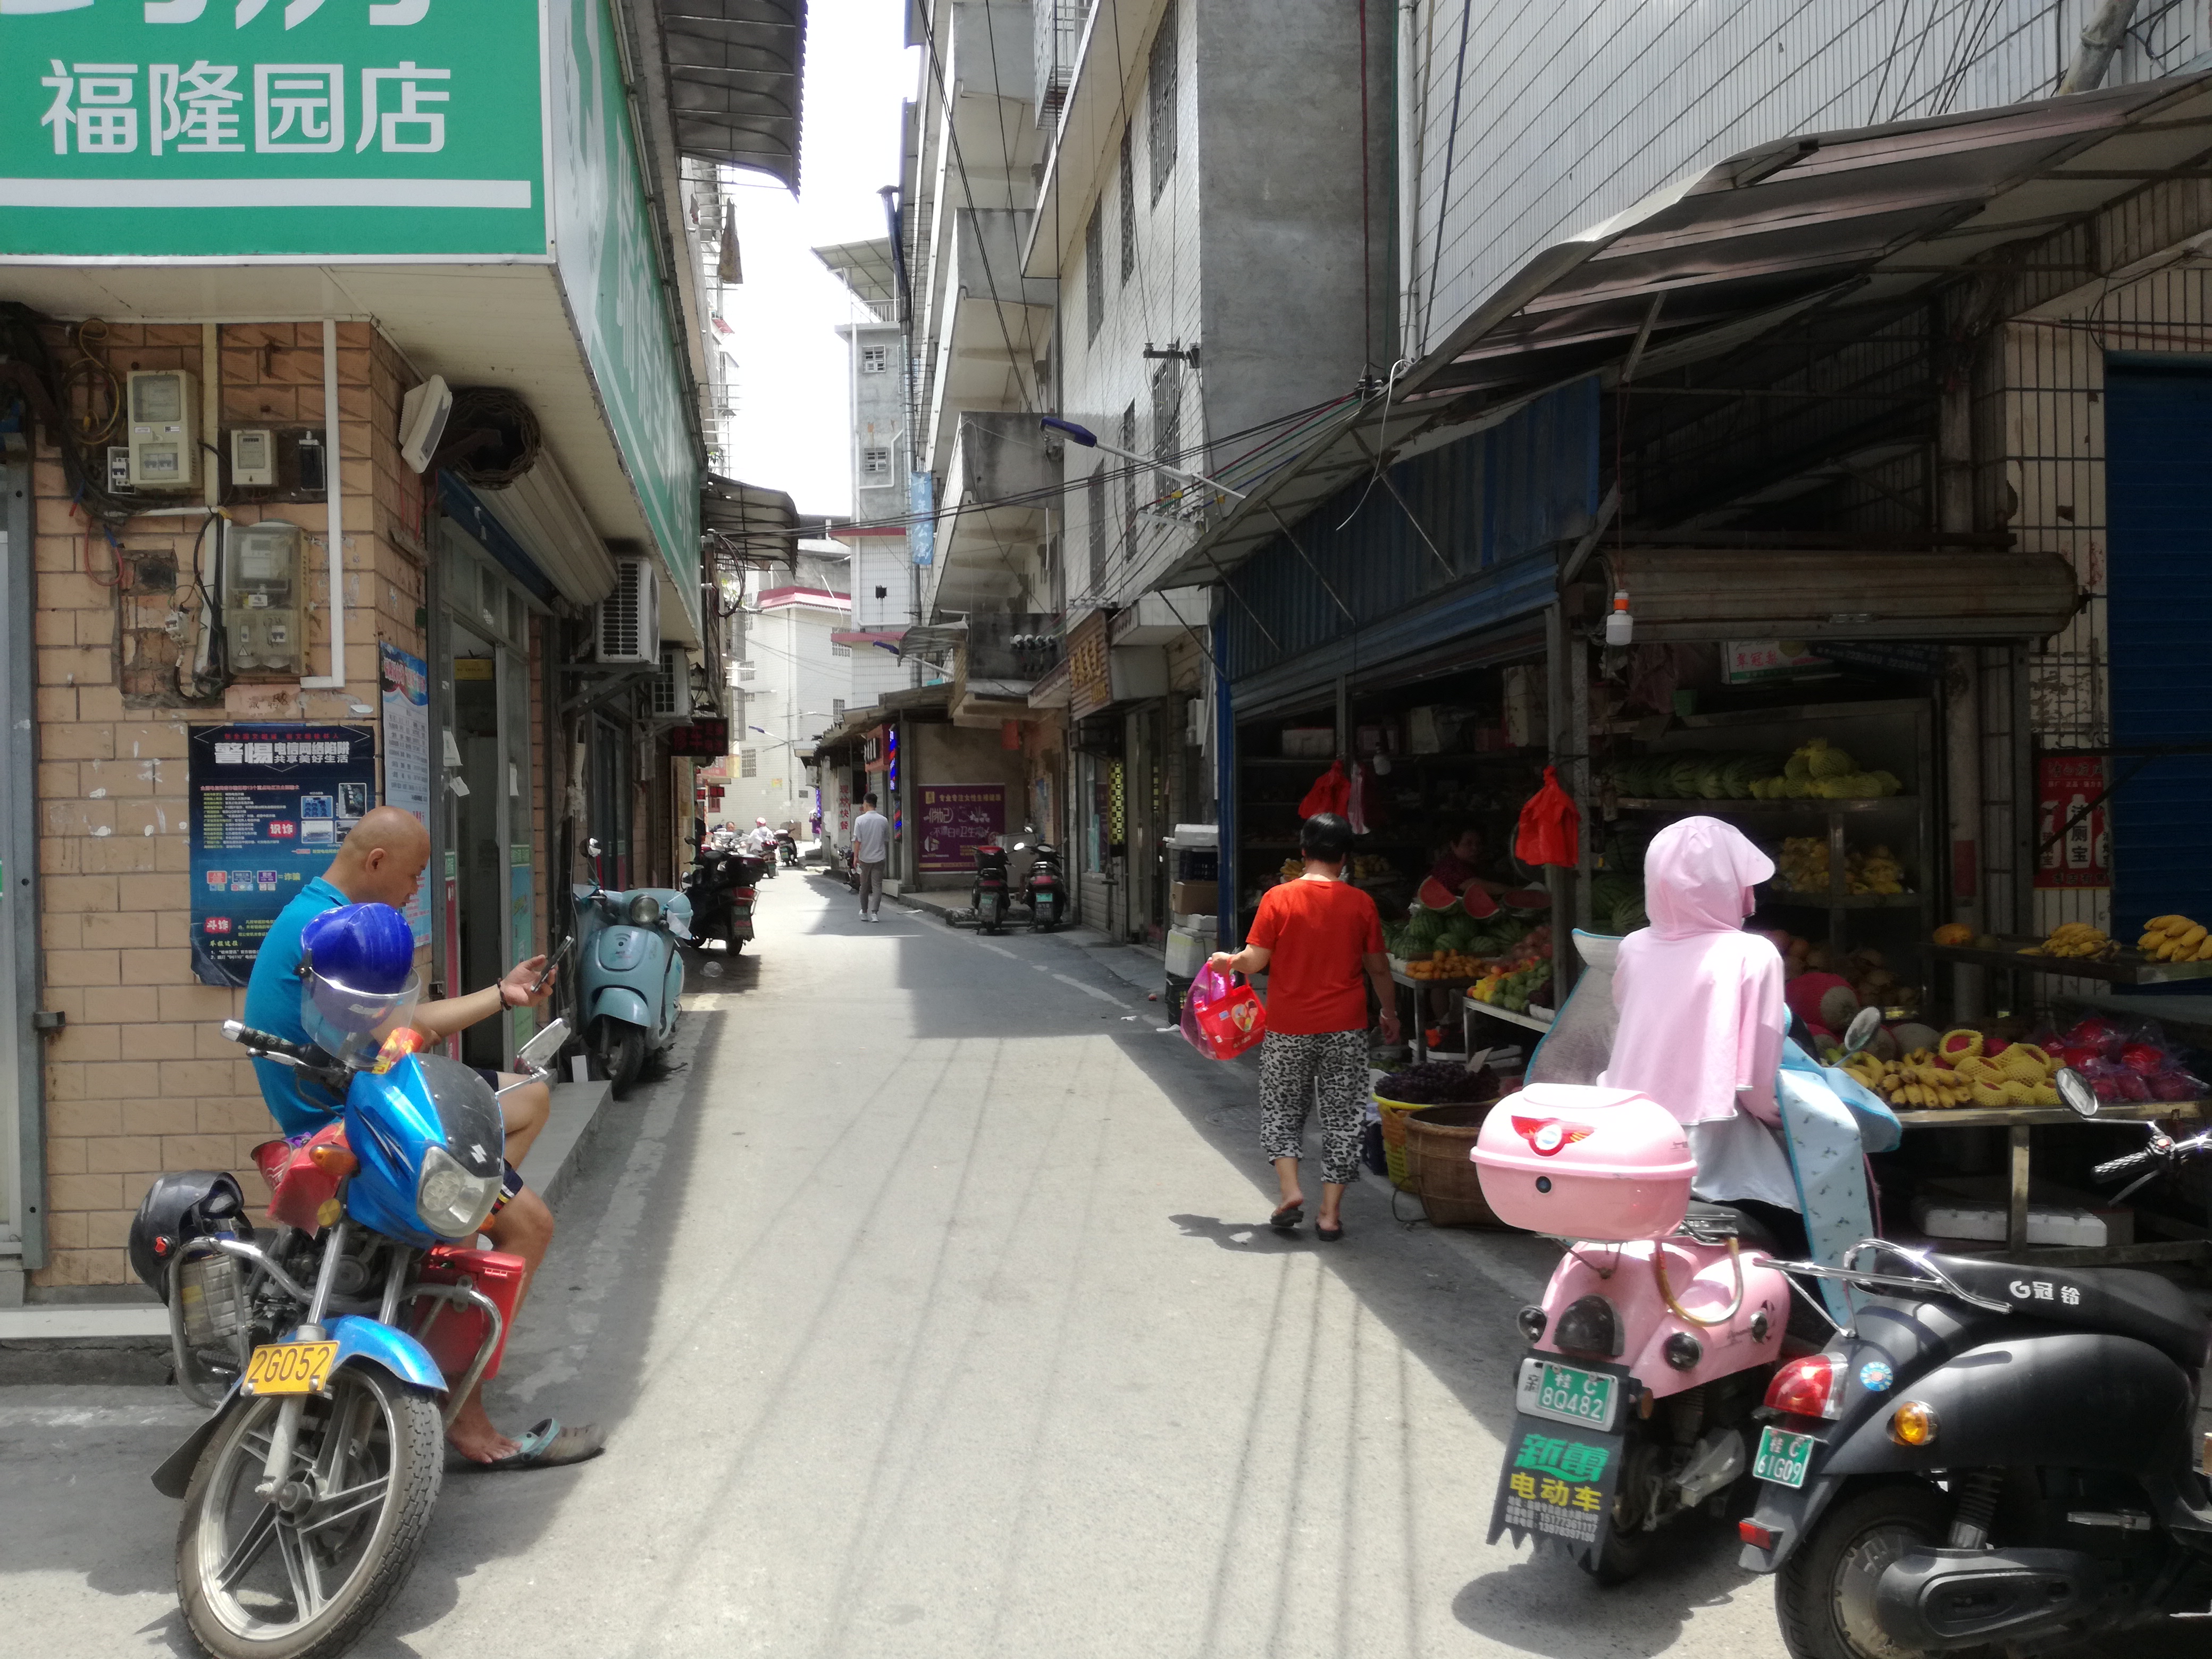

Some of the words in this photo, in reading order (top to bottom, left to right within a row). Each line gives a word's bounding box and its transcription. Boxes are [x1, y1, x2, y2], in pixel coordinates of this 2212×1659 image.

[41, 60, 451, 156] 福隆园店
[616, 112, 693, 571] 瑞德堂大药房
[214, 742, 273, 764] 警惕
[274, 755, 349, 764] 共享美好生活
[270, 824, 293, 834] 识诈
[248, 1346, 330, 1383] 2G052
[1543, 1386, 1603, 1419] 8Q482
[1757, 1454, 1802, 1482] 61G09
[1510, 1472, 1603, 1512] 电动车
